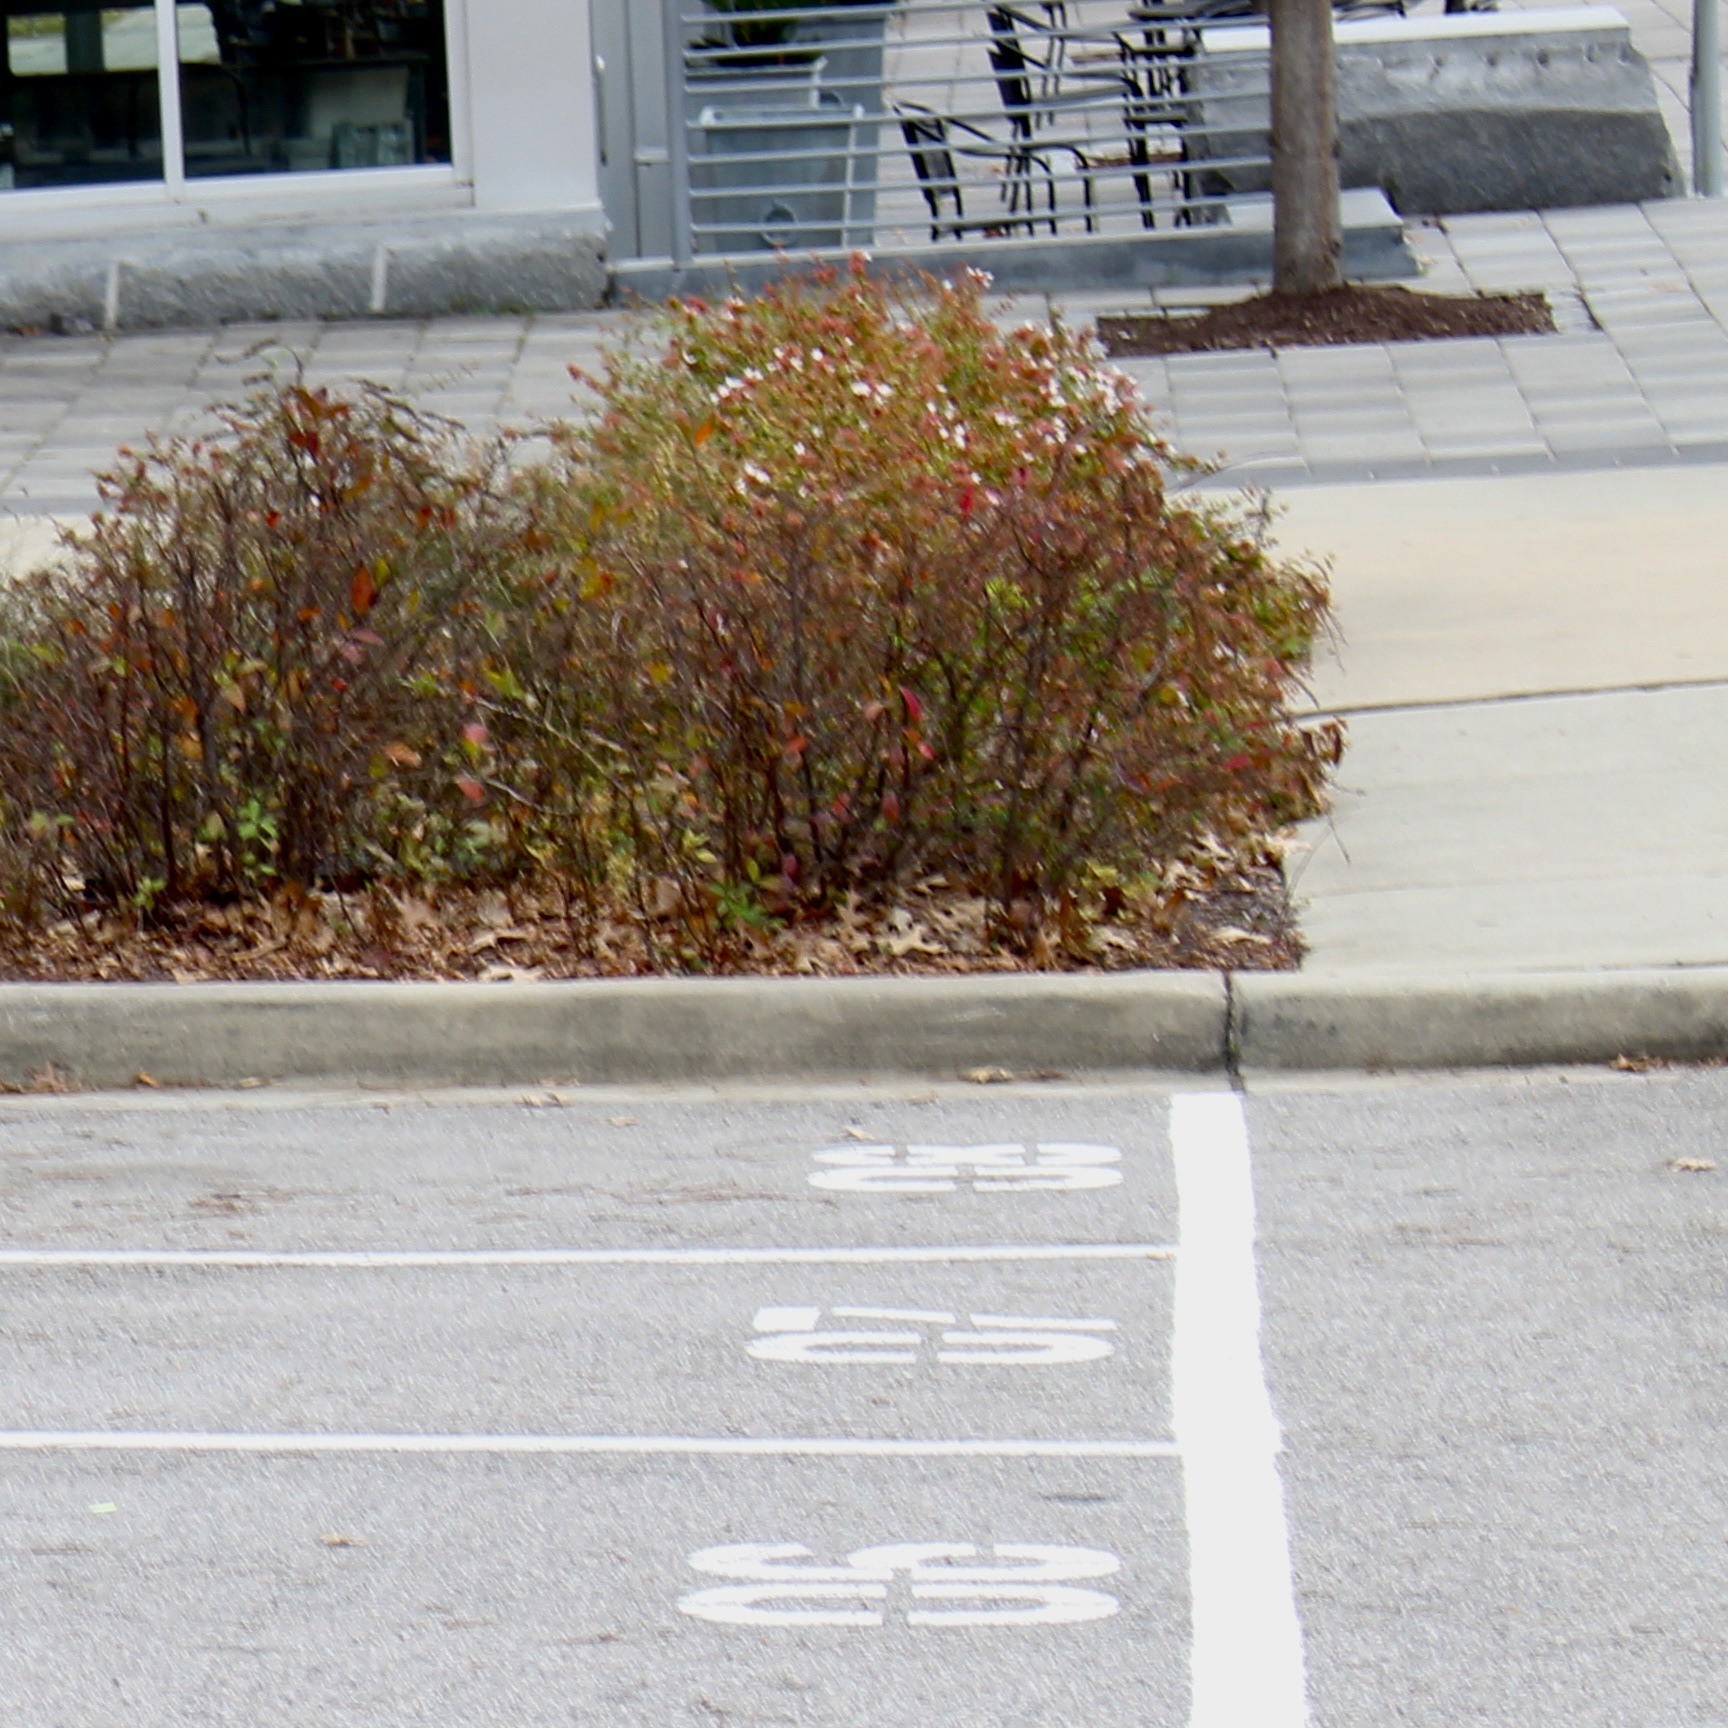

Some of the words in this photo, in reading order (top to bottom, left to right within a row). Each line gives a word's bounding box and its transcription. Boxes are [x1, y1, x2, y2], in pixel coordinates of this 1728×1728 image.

[807, 1142, 1124, 1192] 08
[745, 1306, 1119, 1364] 07
[677, 1541, 1121, 1626] 06
